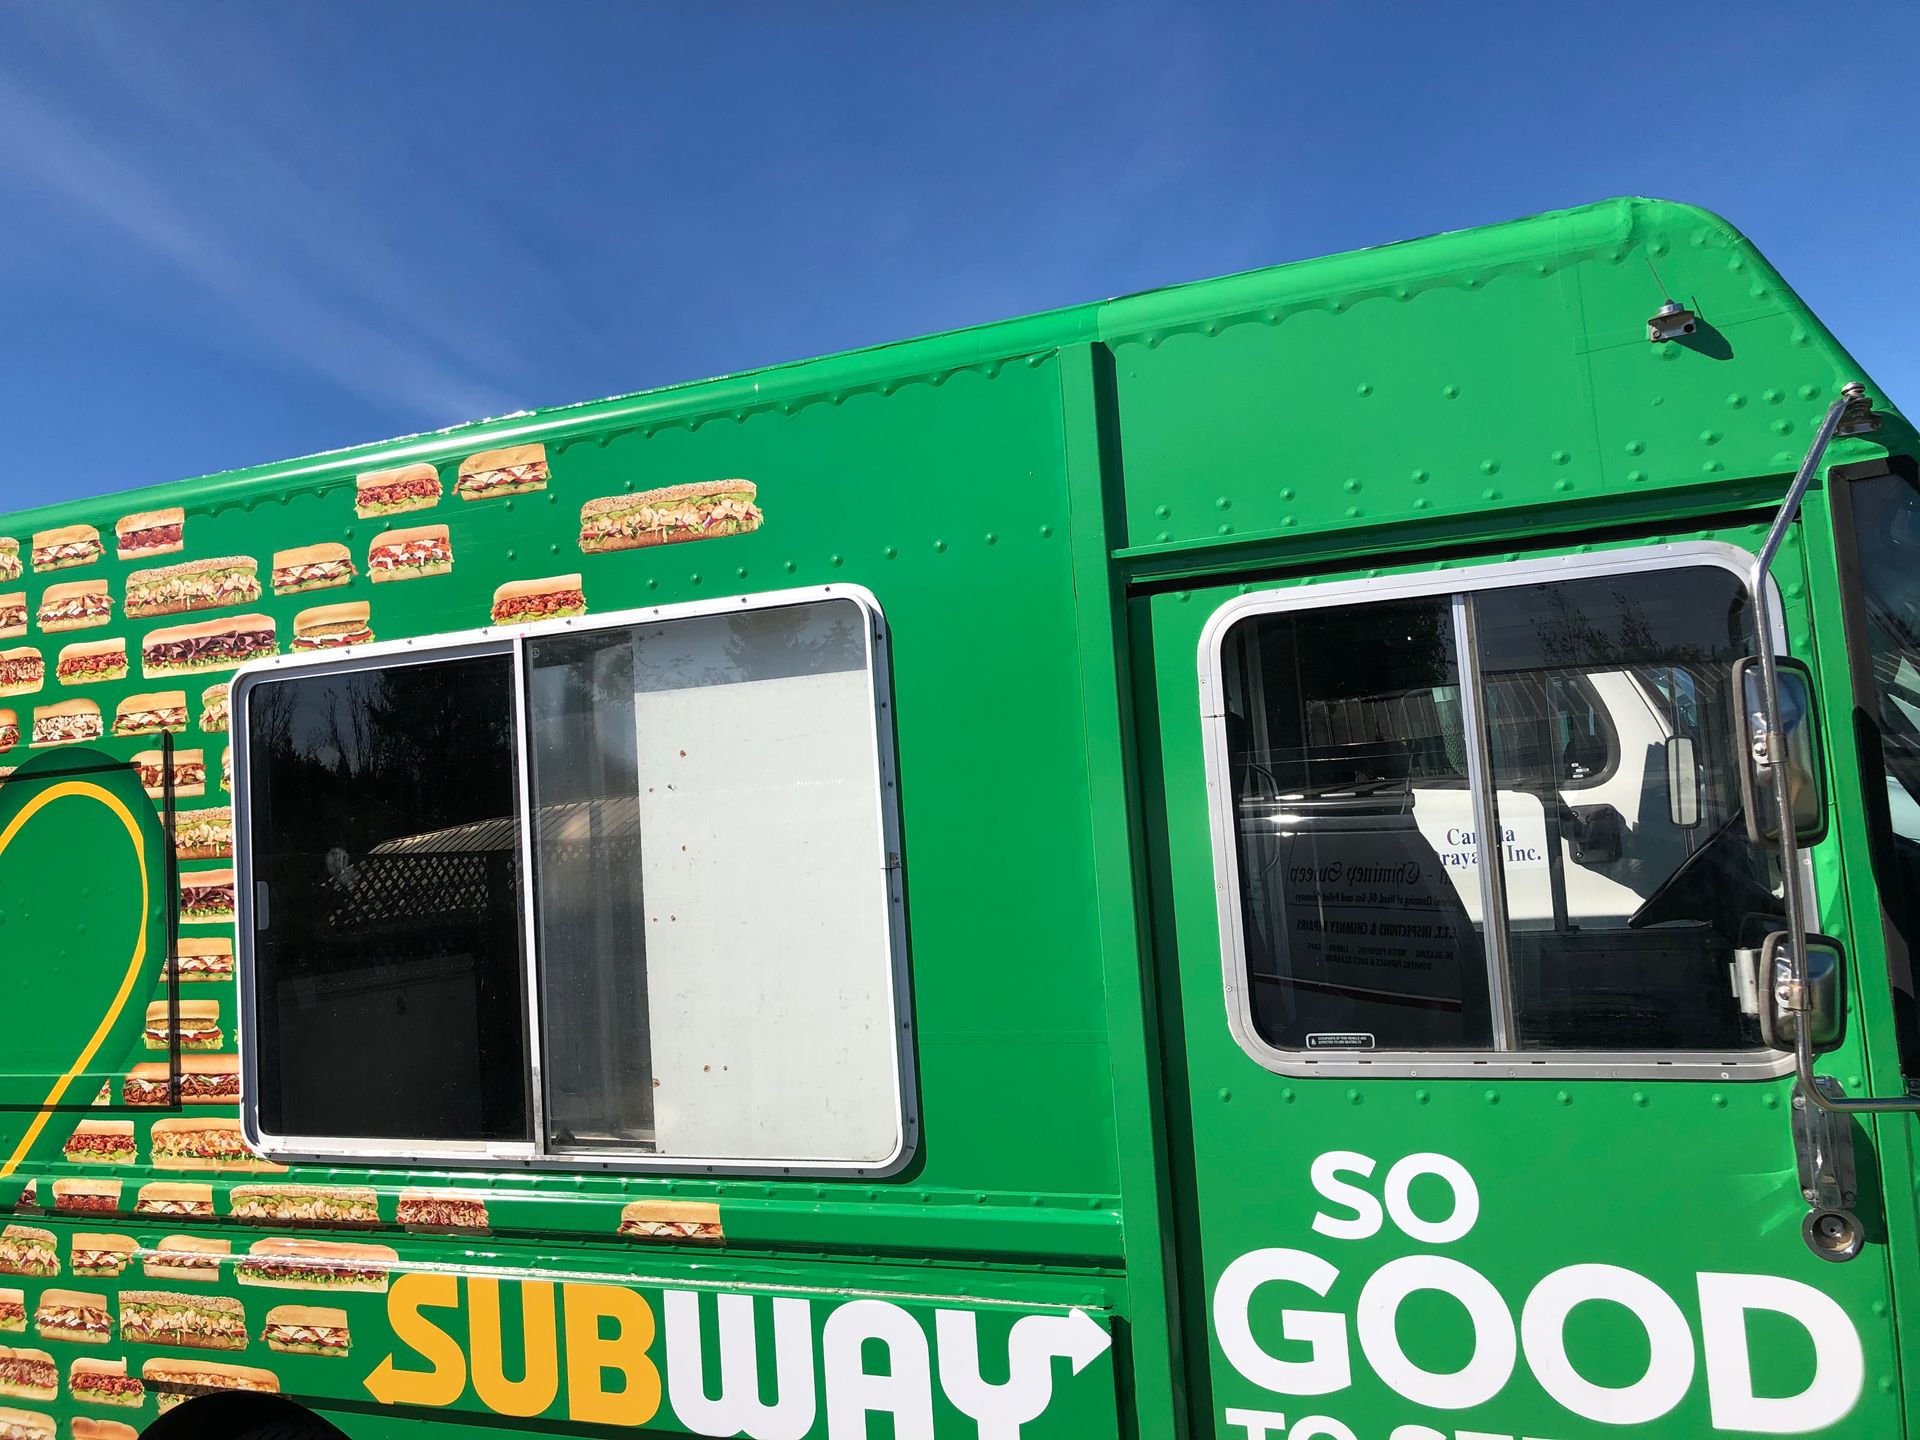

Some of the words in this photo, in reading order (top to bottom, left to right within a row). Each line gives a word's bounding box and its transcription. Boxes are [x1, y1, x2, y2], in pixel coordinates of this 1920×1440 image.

[1506, 844, 1541, 862] Inc.
[1310, 1150, 1480, 1244] SO
[362, 1273, 1113, 1440] SUBWAY
[1212, 1247, 1866, 1434] GOOD
